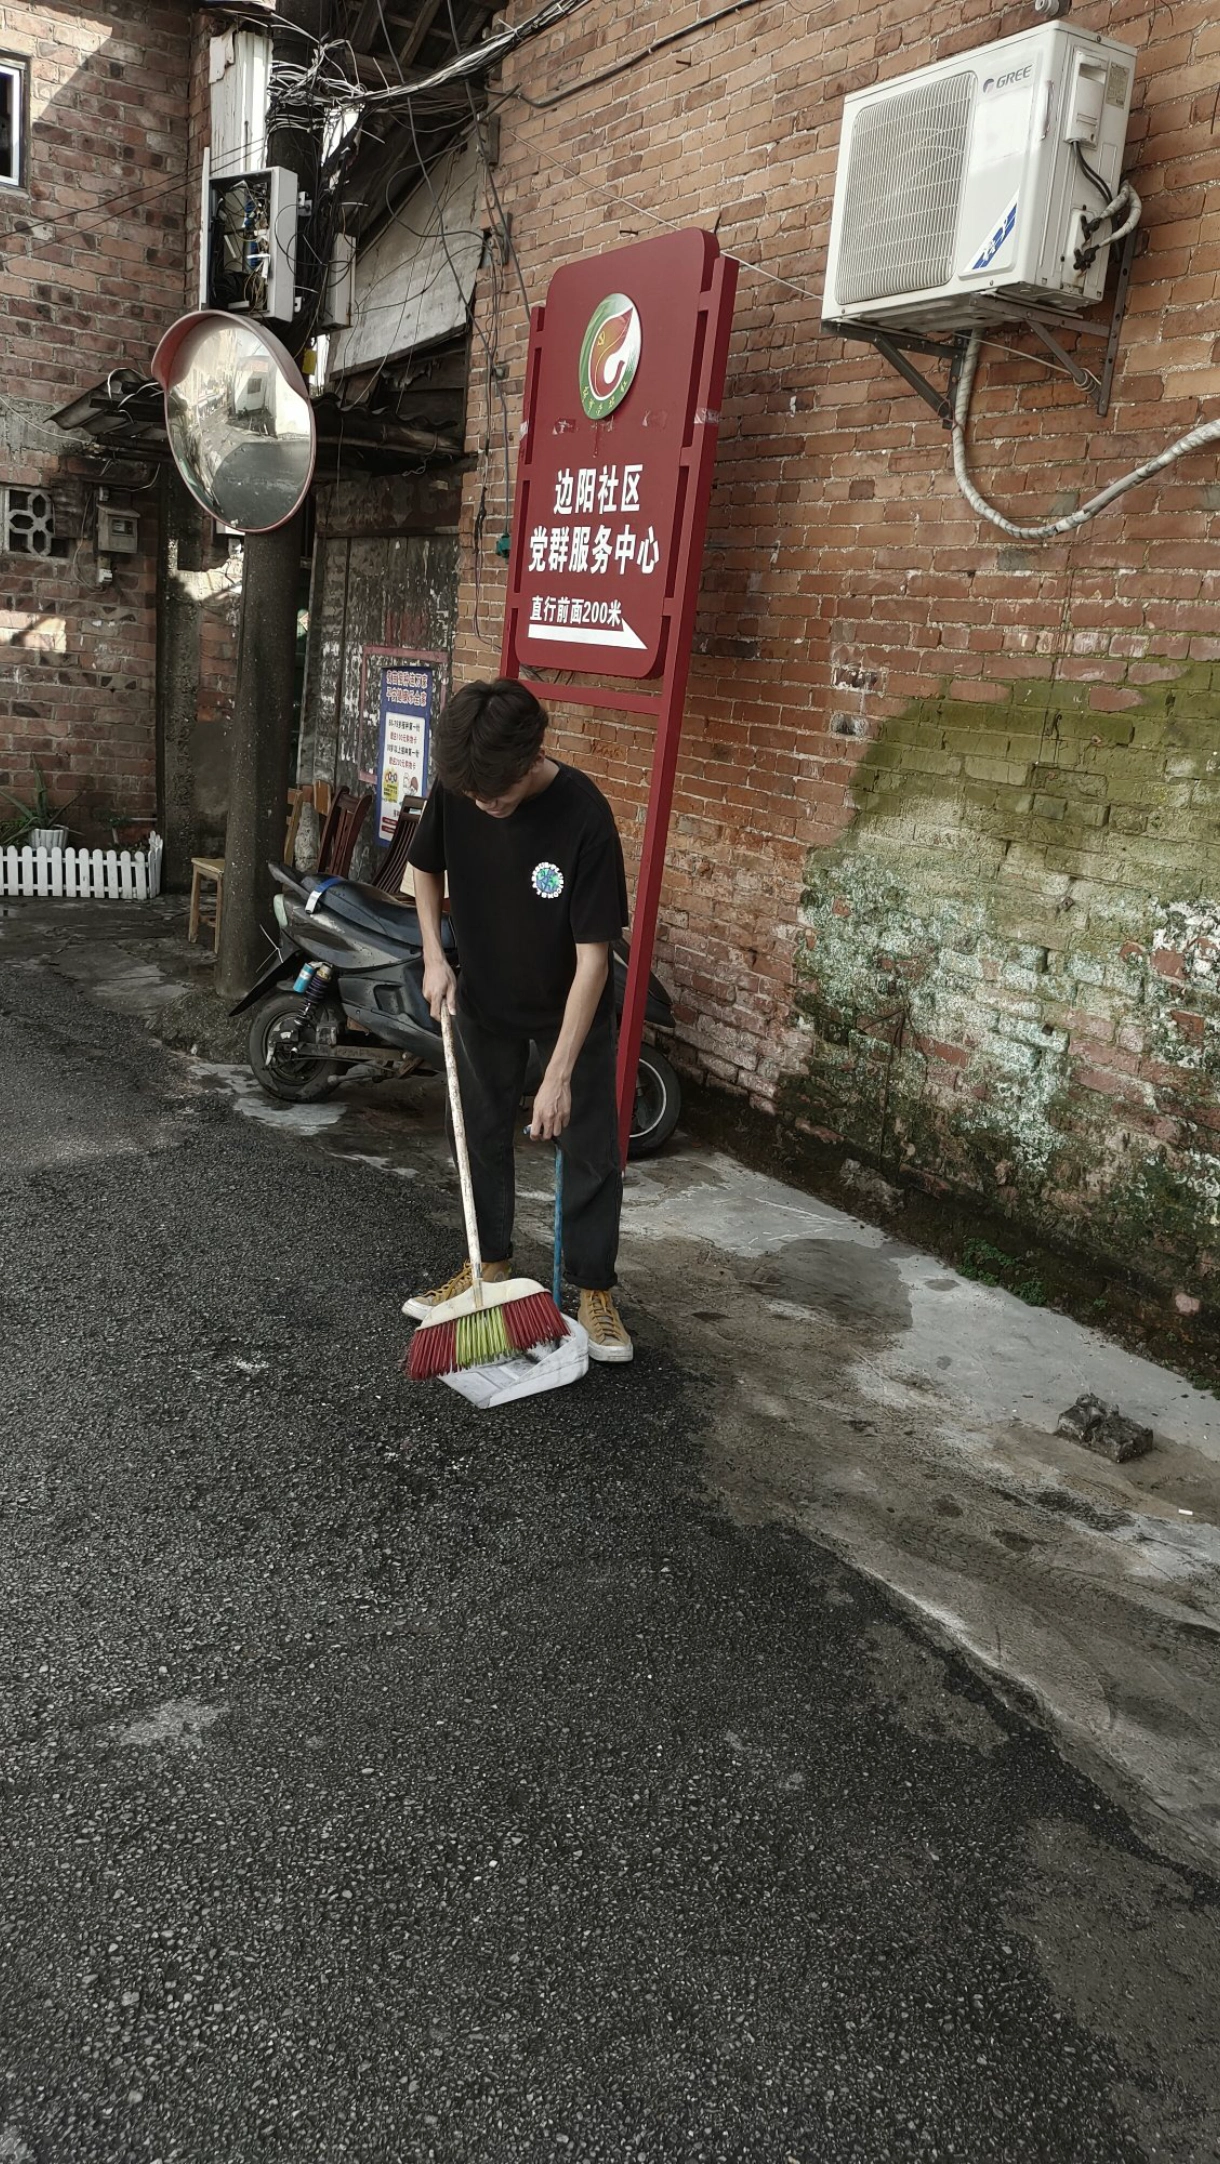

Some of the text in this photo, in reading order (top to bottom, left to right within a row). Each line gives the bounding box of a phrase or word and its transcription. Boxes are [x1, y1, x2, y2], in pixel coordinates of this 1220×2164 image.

[995, 65, 1033, 89] GREE
[553, 464, 643, 514] 边阳社区
[528, 524, 660, 575] 党群服务中心
[529, 595, 622, 627] 直行前面200米
